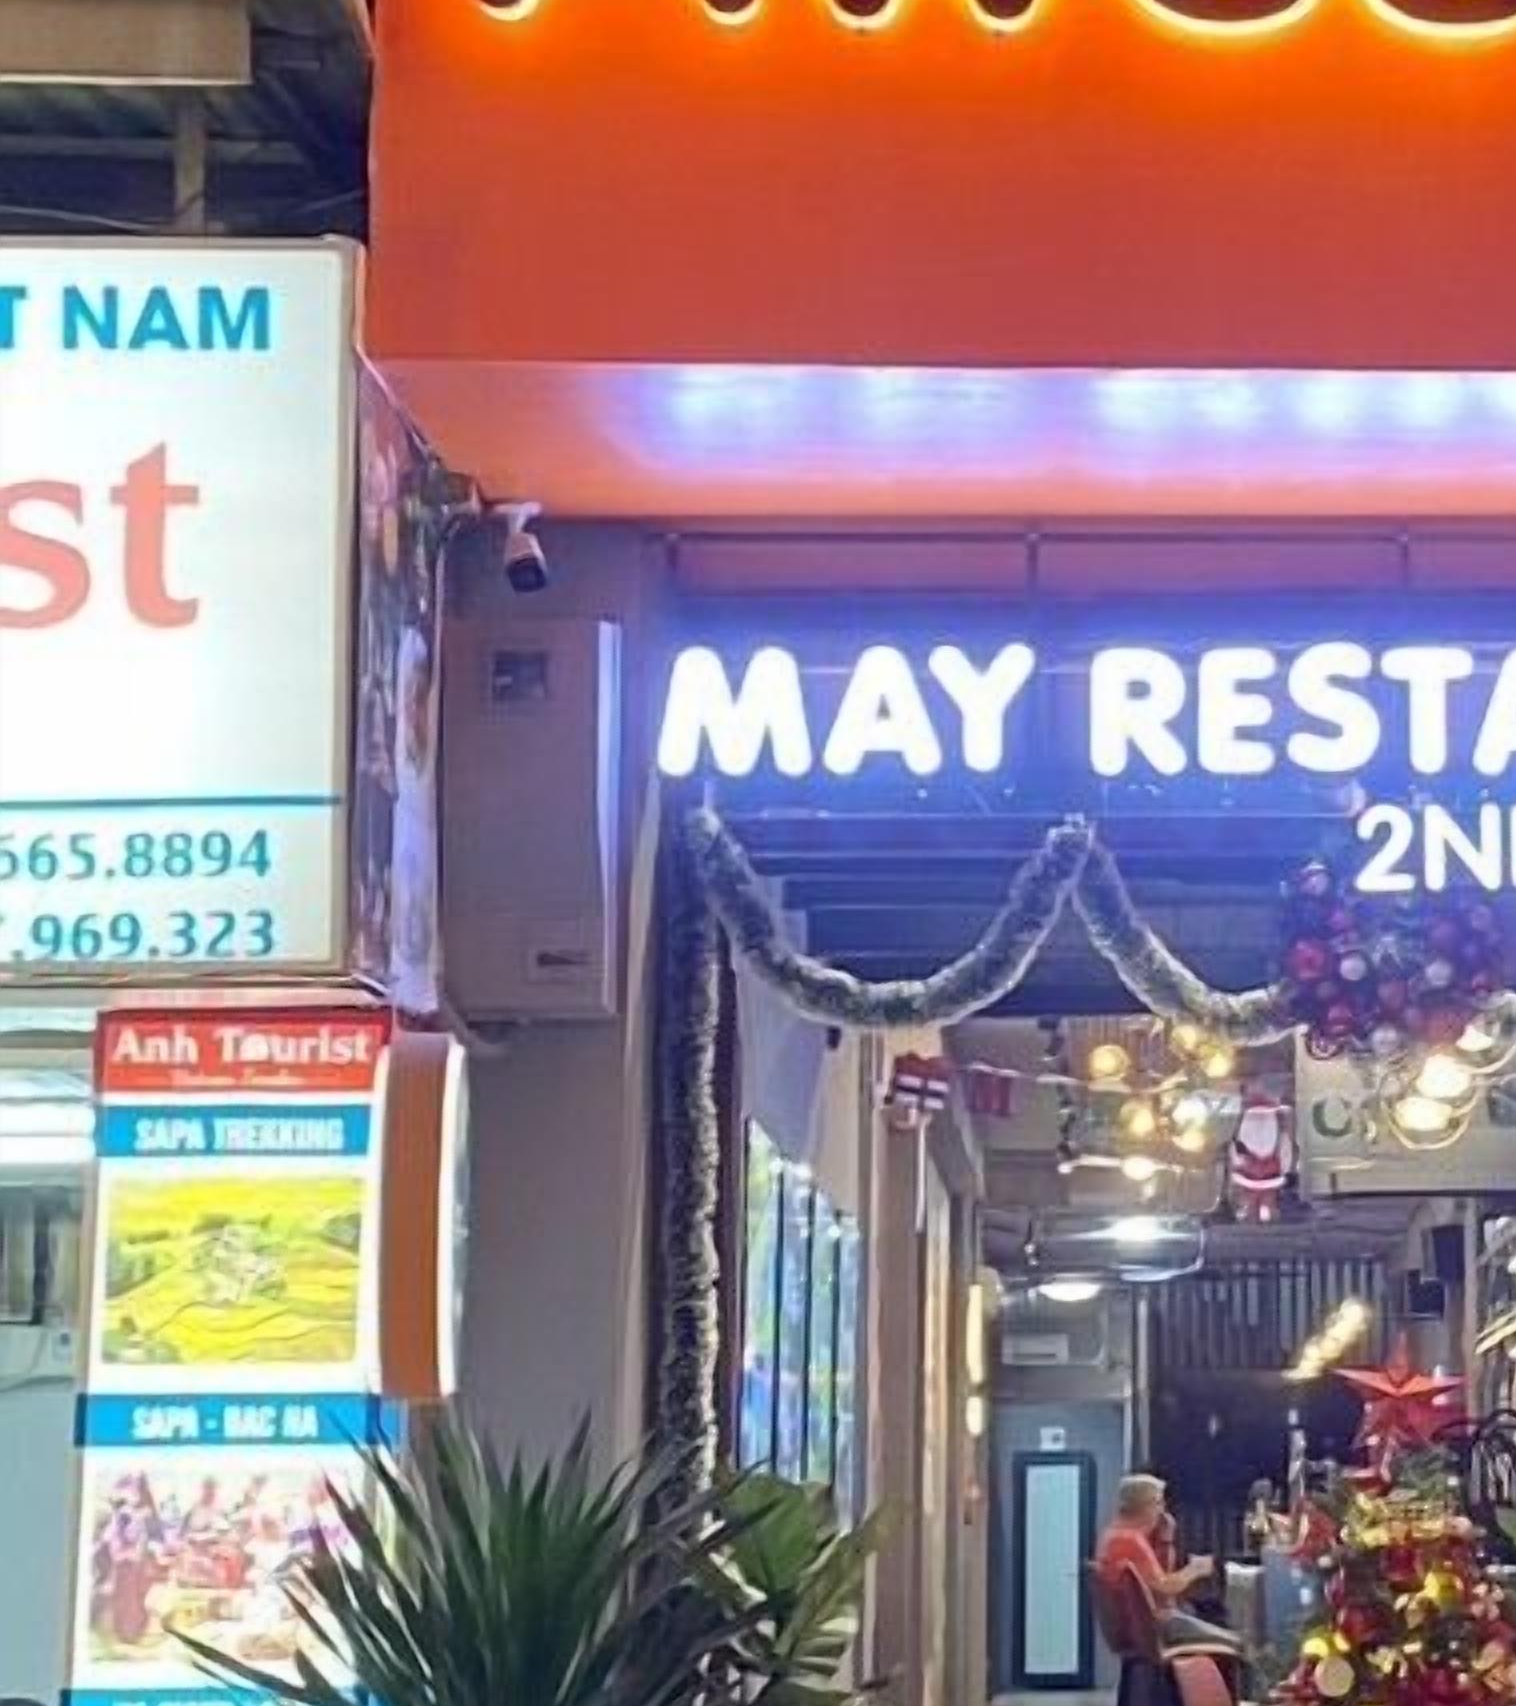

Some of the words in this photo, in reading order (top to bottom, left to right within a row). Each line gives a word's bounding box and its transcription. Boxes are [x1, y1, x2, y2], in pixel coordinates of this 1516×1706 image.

[63, 285, 270, 349] NAM
[658, 643, 1036, 777] MAY
[0, 909, 275, 960] .969.323
[112, 1024, 199, 1064] Anh
[213, 1024, 371, 1065] Tourist
[135, 1116, 206, 1150] SAPA
[213, 1116, 345, 1150] TREKKING
[131, 1405, 199, 1438] SAPA
